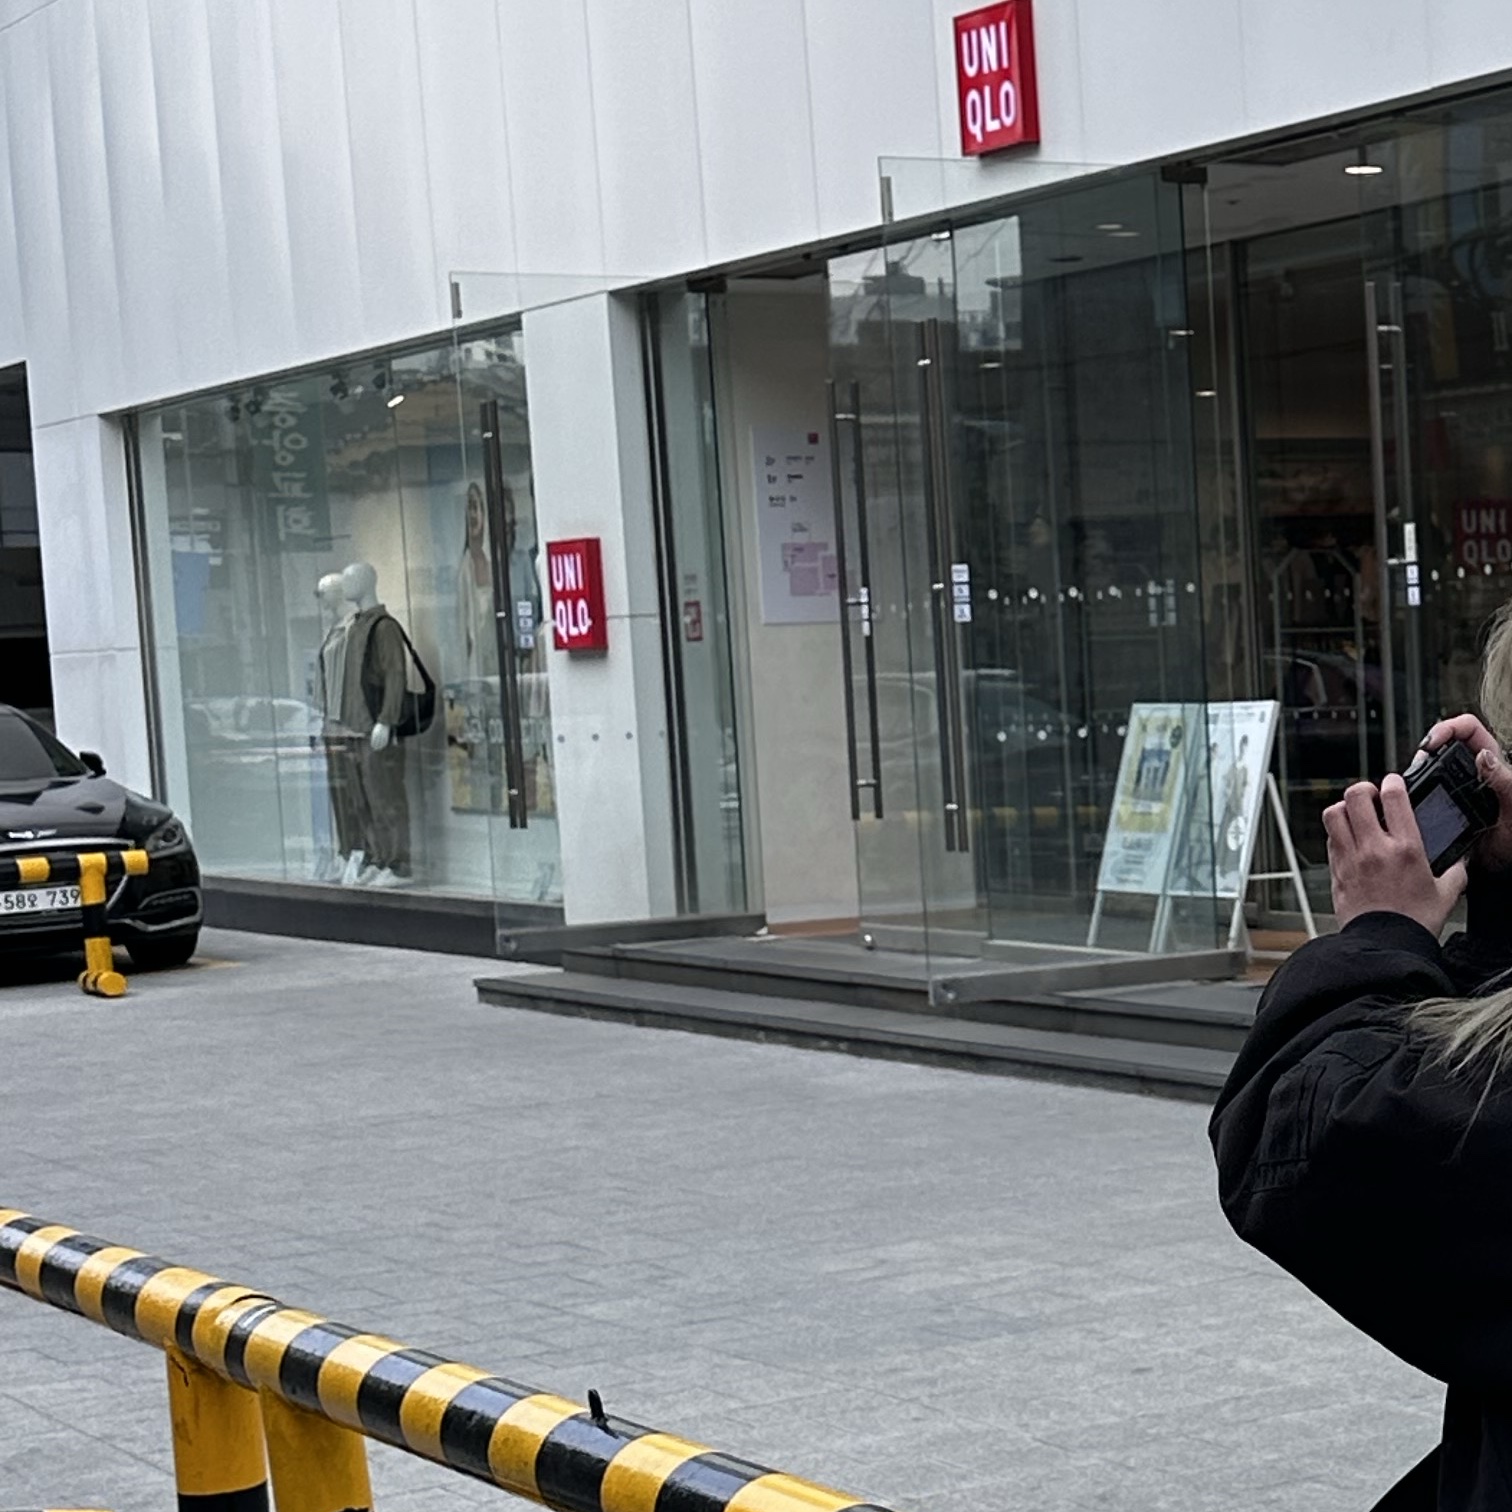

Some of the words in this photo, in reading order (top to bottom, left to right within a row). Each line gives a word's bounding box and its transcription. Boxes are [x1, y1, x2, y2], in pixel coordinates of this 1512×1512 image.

[961, 21, 1009, 77] UNI
[965, 80, 1016, 143] QLO
[1461, 508, 1507, 534] UNI
[1462, 538, 1512, 567] QLO
[551, 553, 583, 592] UNI
[555, 599, 589, 644] QLO
[1, 892, 38, 911] 58오
[46, 888, 81, 907] 739
